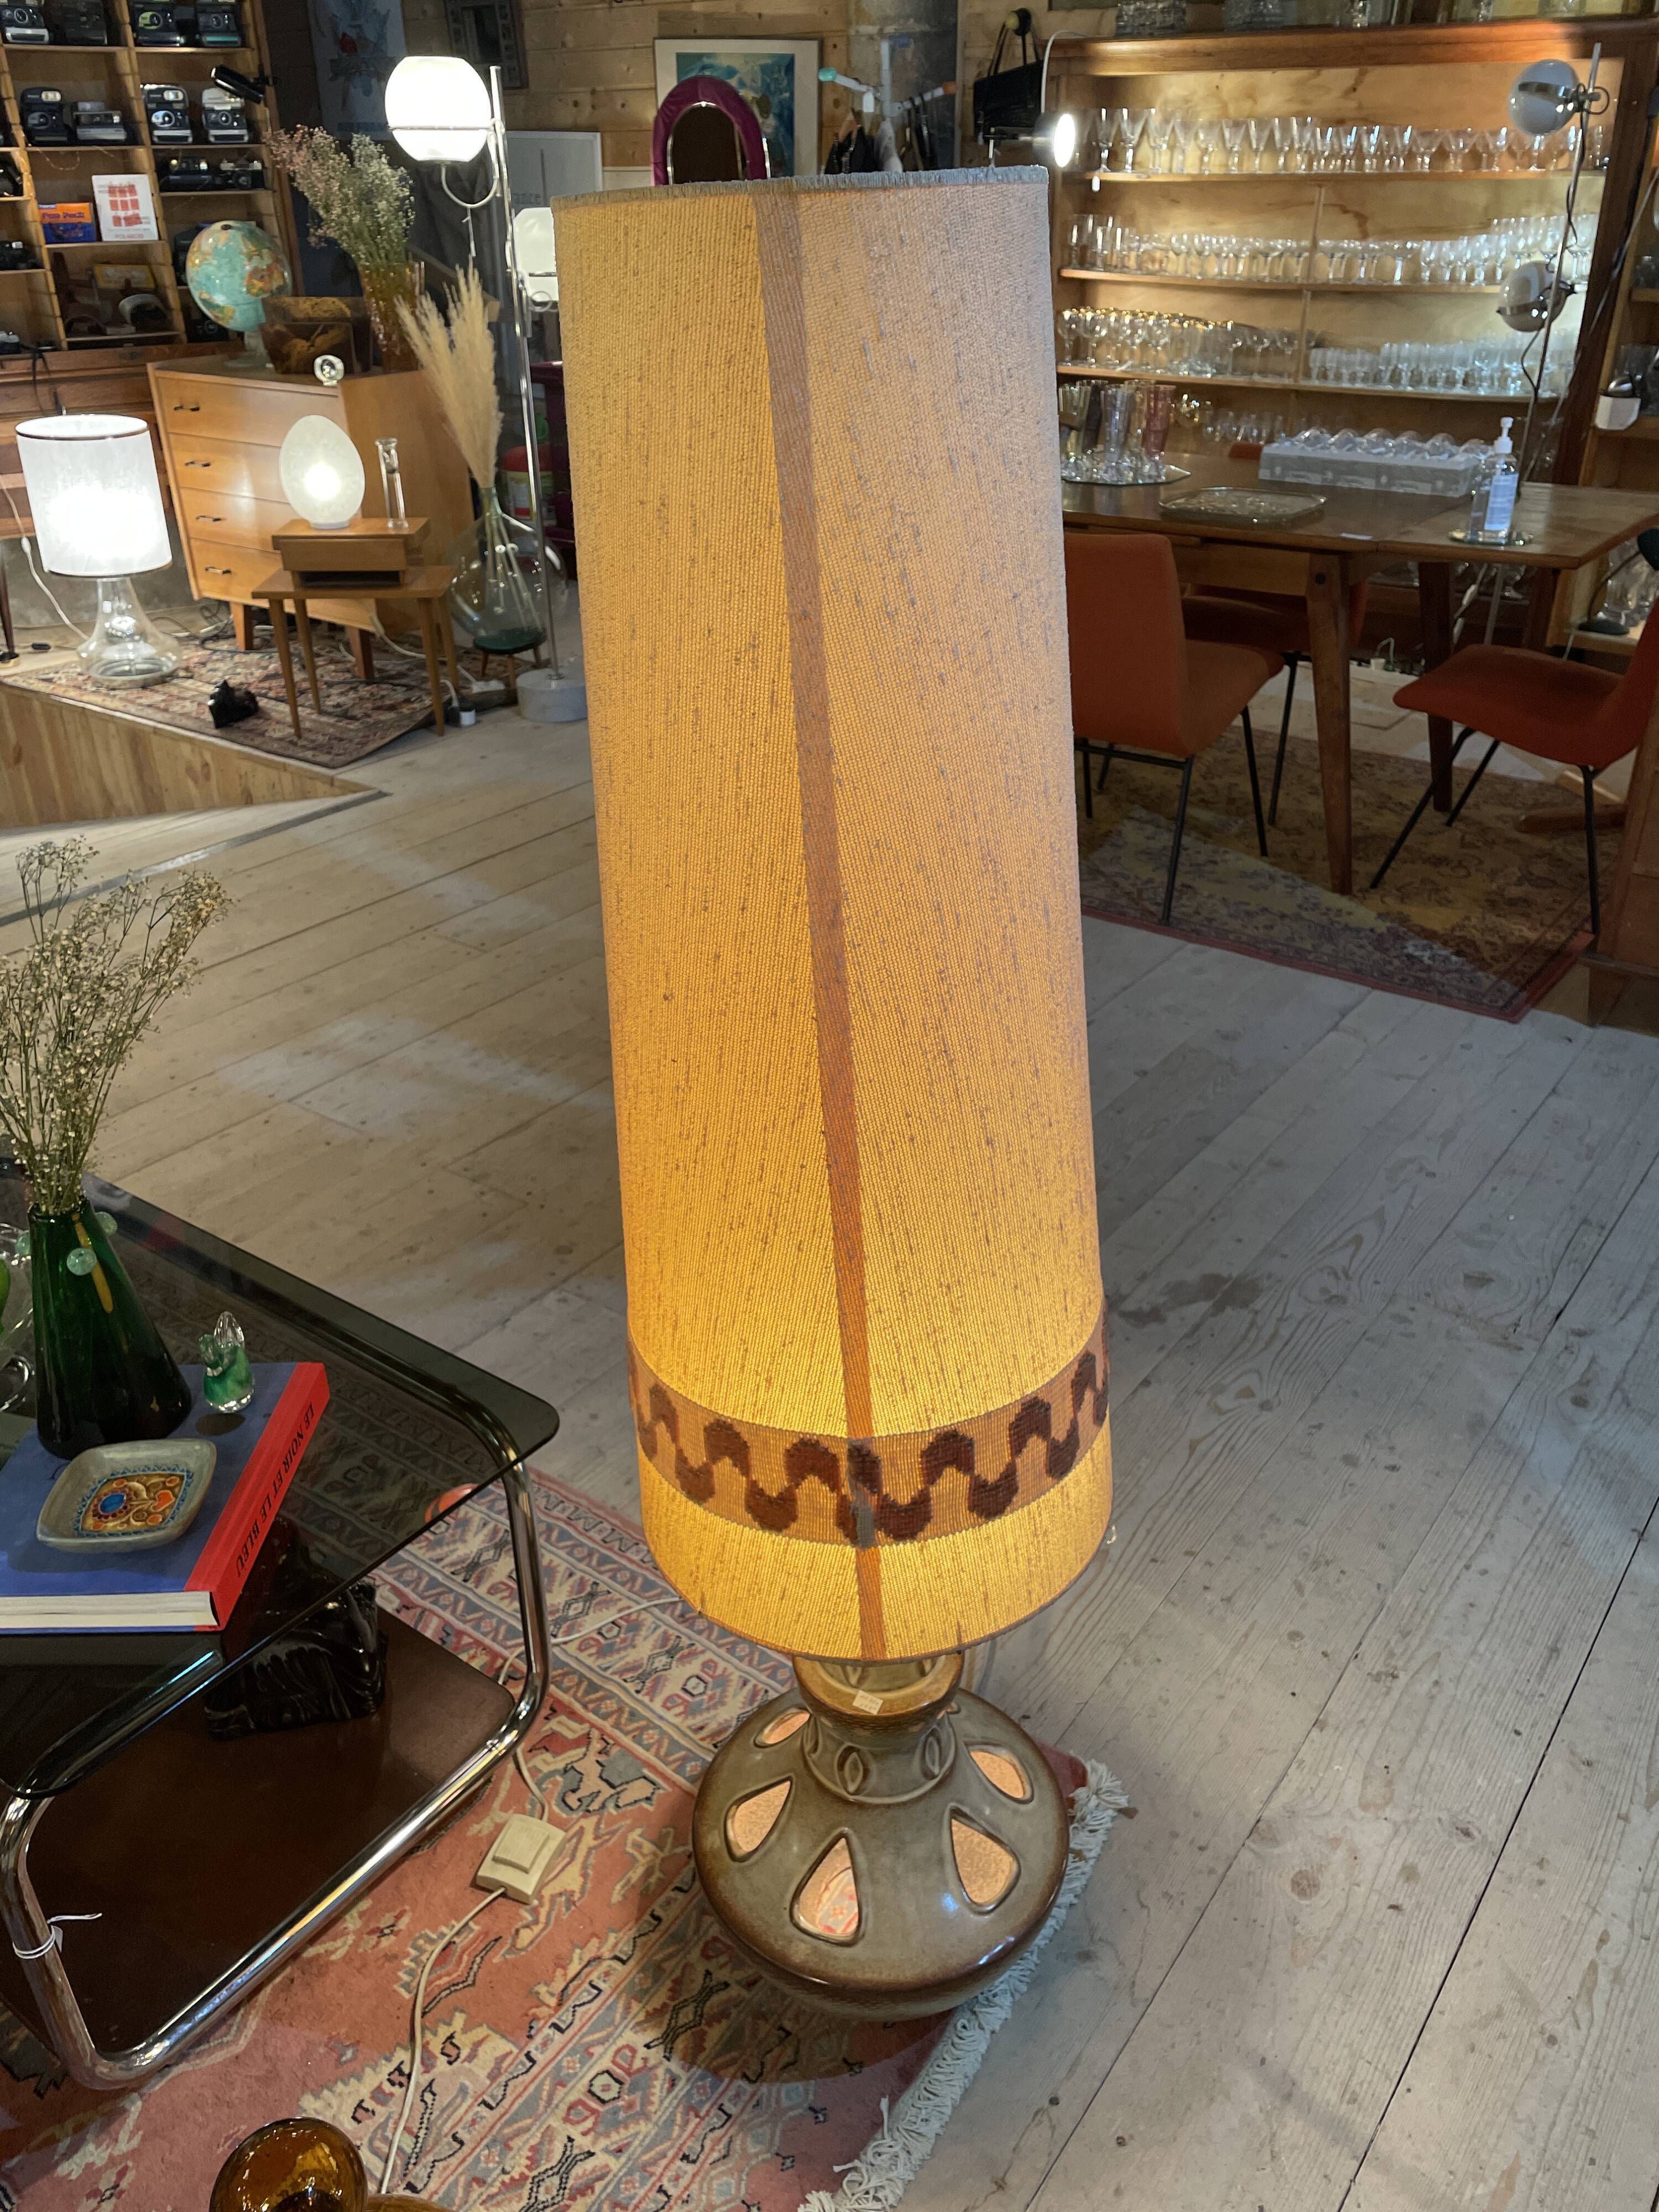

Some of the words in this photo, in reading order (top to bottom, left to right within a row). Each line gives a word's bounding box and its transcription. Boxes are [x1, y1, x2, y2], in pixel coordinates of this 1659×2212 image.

[304, 1402, 315, 1430] LE
[283, 1423, 304, 1474] NOIR
[273, 1468, 283, 1499] ET
[260, 1493, 272, 1524] LE
[236, 1519, 260, 1577] BLEU
